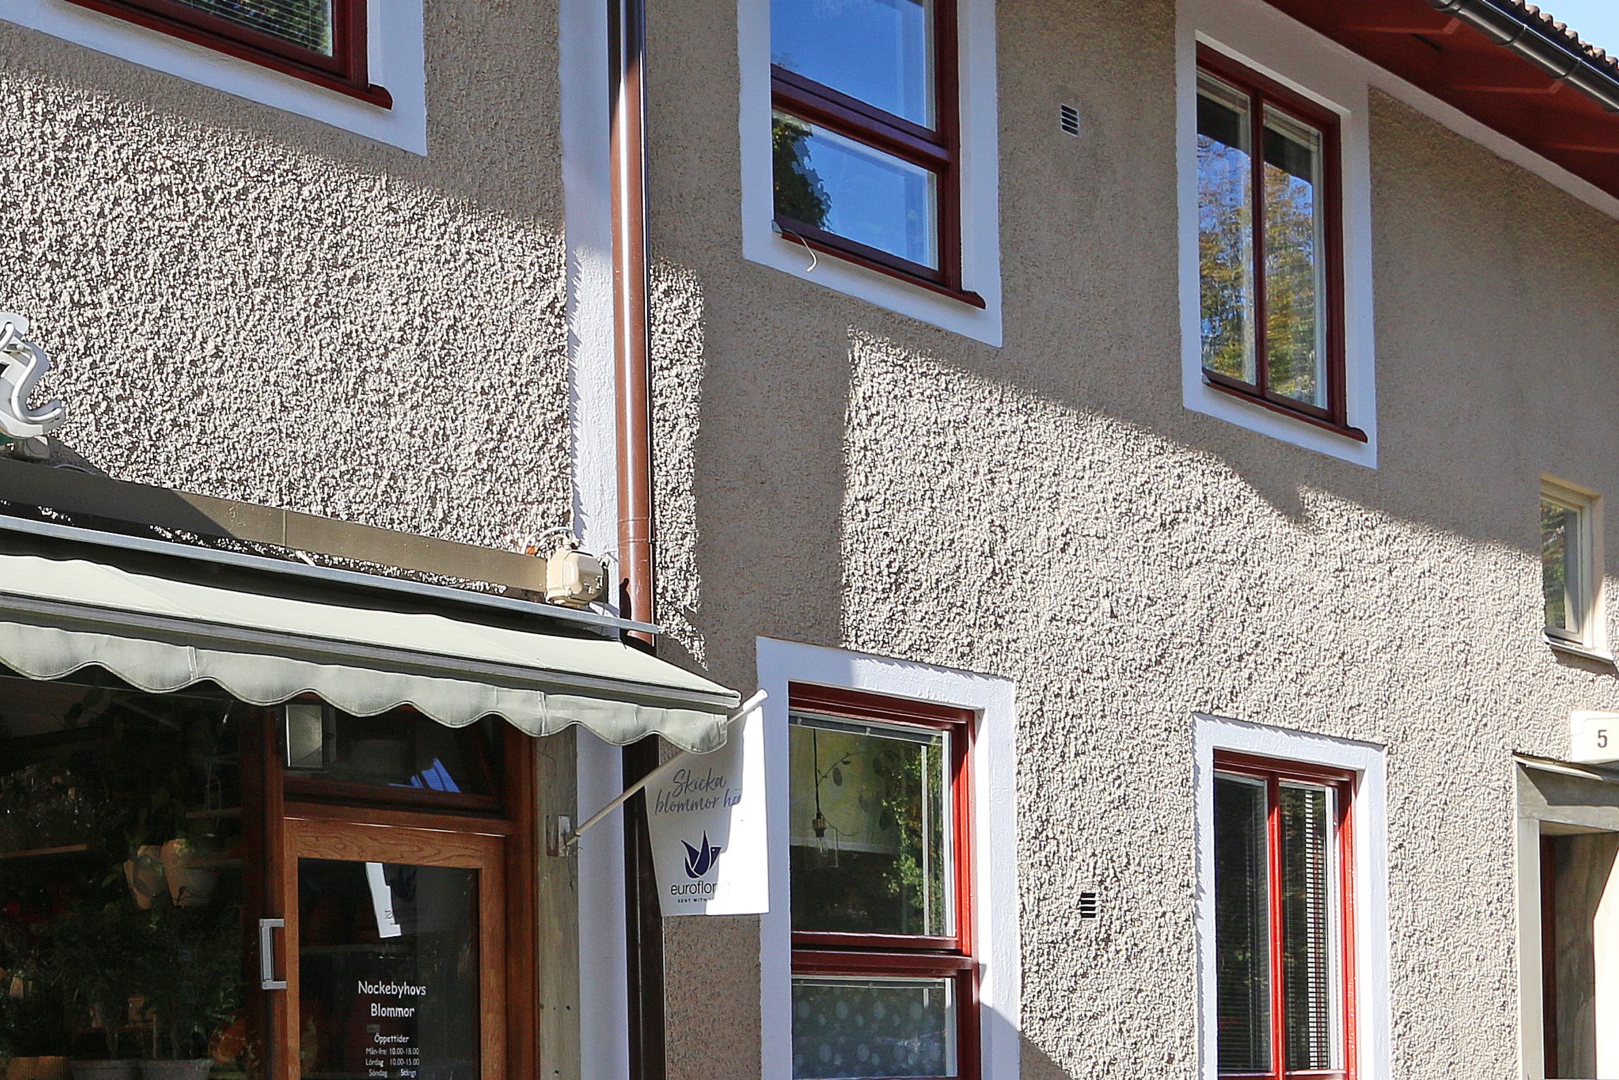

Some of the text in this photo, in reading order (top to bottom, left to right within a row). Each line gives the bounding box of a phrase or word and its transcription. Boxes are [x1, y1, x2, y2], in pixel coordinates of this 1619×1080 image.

[1597, 729, 1608, 748] 5
[672, 768, 726, 797] Skicka
[655, 789, 720, 816] blommor
[358, 980, 427, 999] Nockebyhovs
[370, 1003, 415, 1017] Blommor
[374, 1032, 409, 1045] Öppettider
[389, 1047, 420, 1055] 10.00-18.00
[365, 1058, 420, 1068] Lördag 10.00-15.00
[368, 1069, 388, 1078] Söndag
